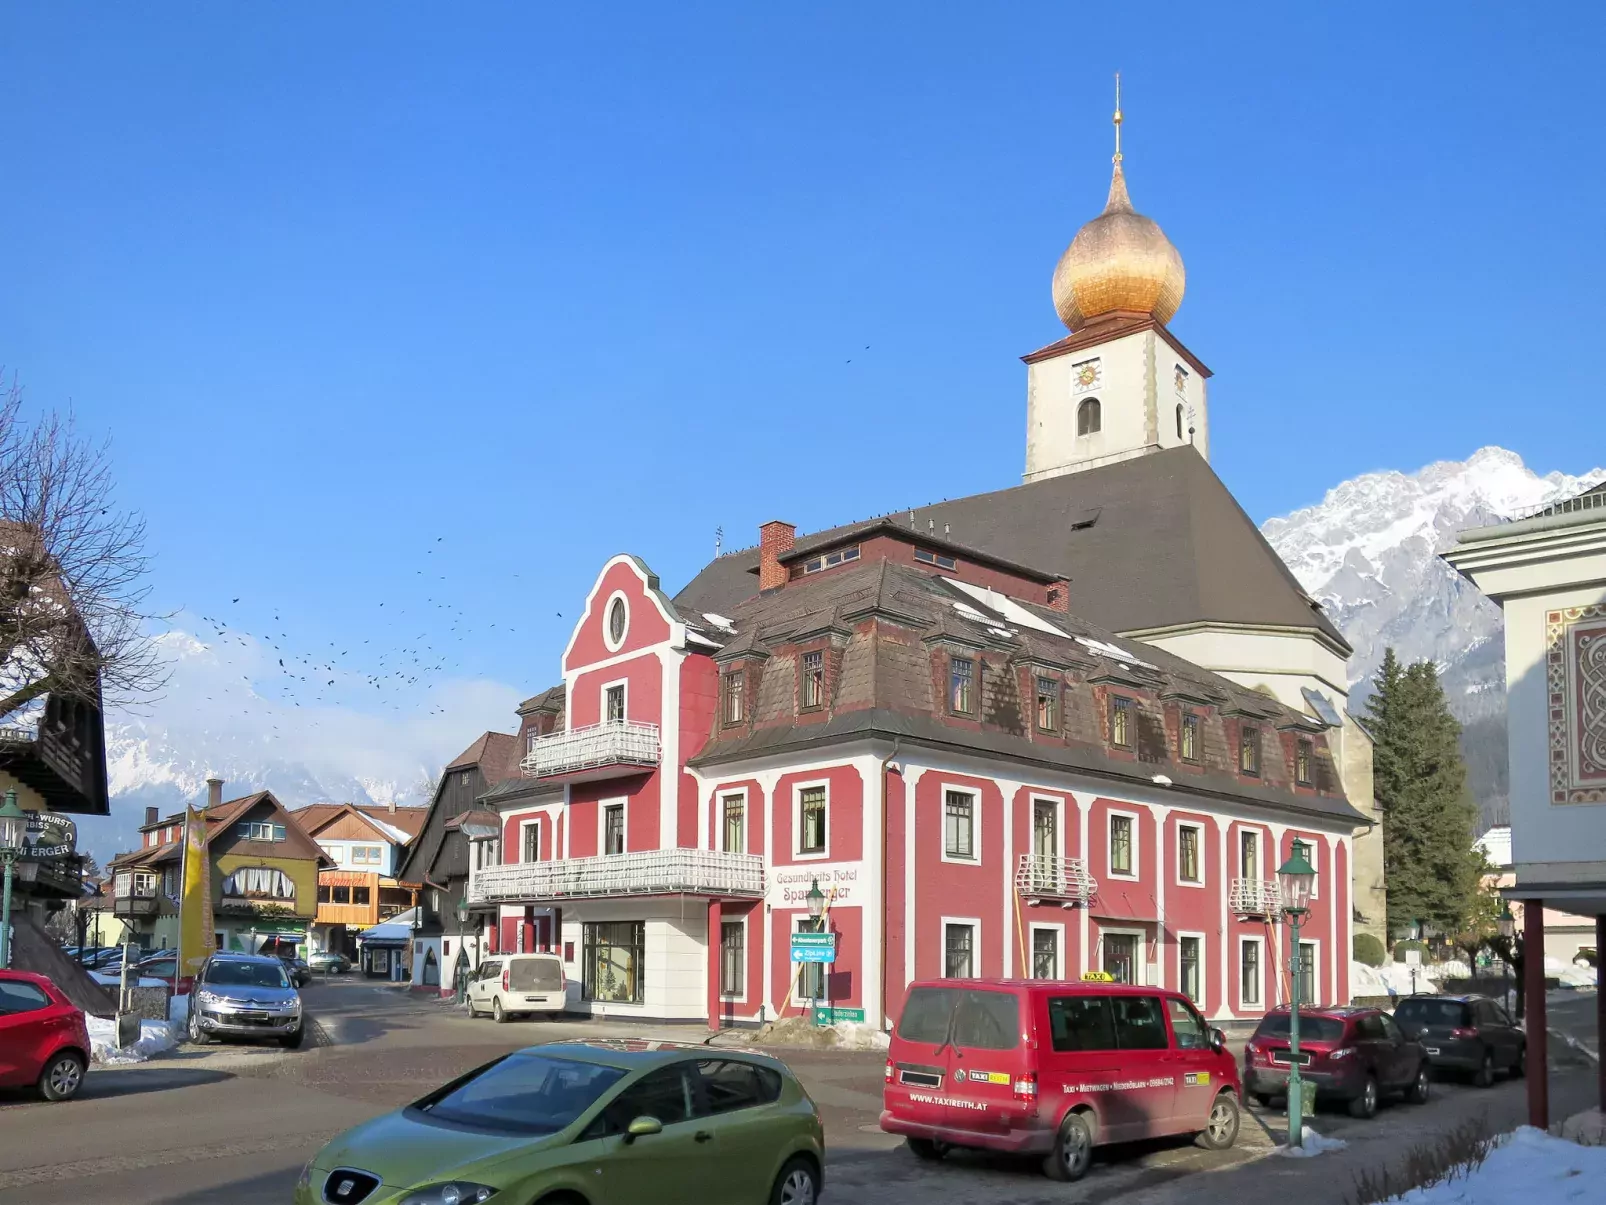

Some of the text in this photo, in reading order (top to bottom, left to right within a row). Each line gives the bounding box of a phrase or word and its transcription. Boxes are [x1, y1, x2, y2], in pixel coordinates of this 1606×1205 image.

[1085, 973, 1106, 981] TAXI
[971, 1072, 988, 1081] TAXI
[909, 1093, 989, 1111] WWW.TAXIREITH.AT
